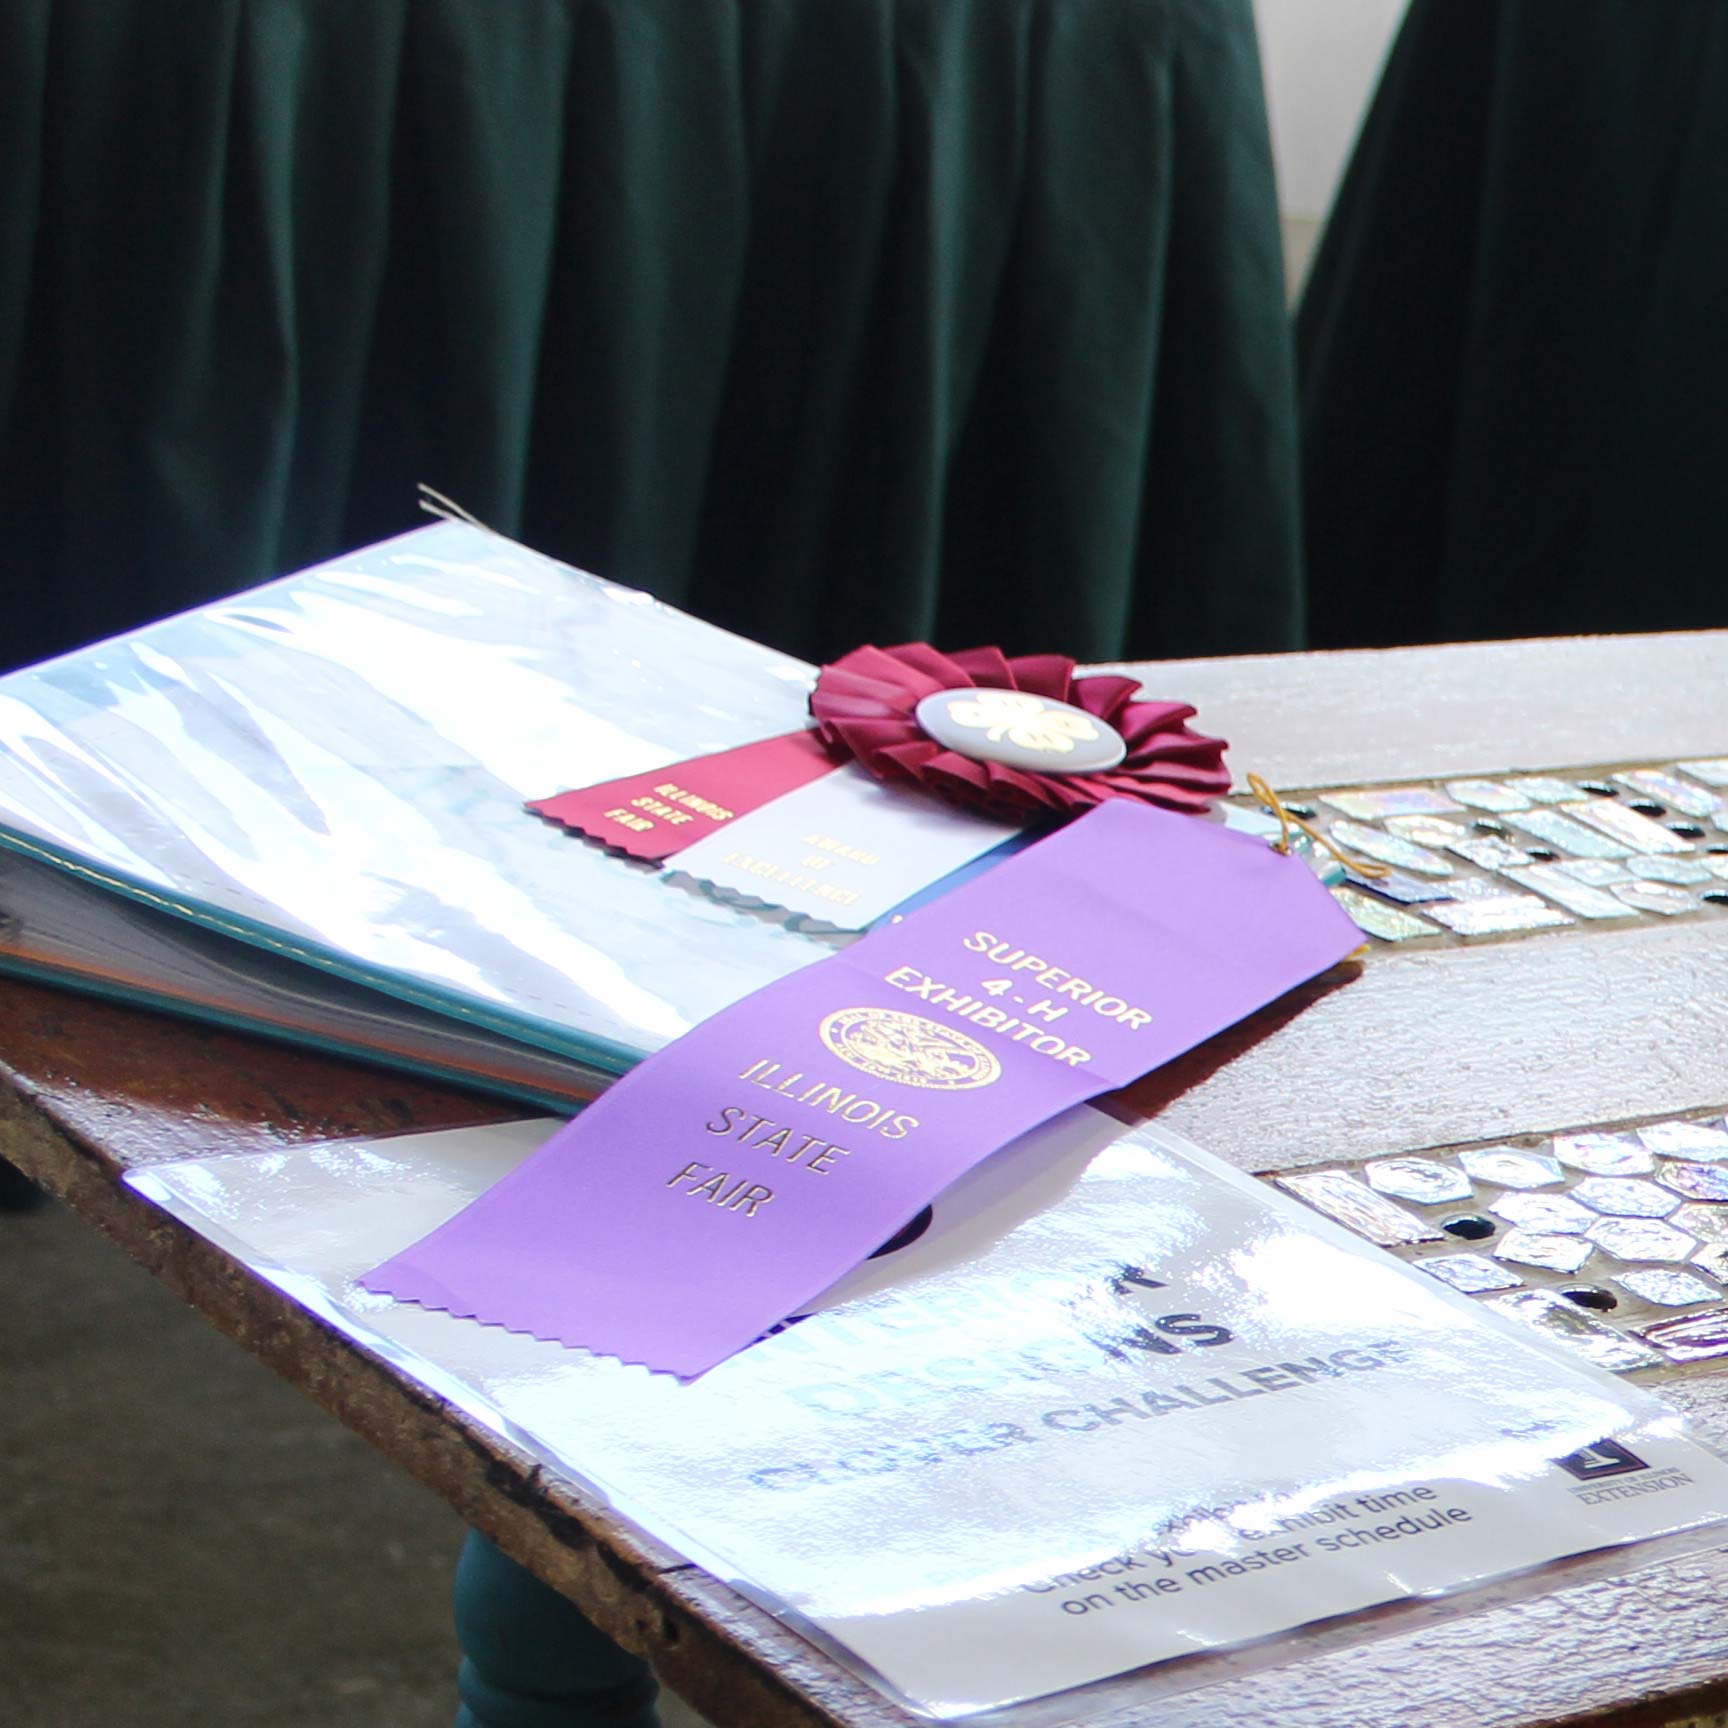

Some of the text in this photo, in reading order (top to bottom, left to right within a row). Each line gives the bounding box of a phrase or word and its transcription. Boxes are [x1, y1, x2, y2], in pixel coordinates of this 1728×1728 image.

[604, 808, 655, 832] FAIR
[631, 796, 694, 825] STATE
[653, 783, 734, 821] ILLINOIS
[963, 931, 1153, 1031] SUPERIOR
[885, 966, 1092, 1067] EXHIBITOR
[738, 1059, 919, 1139] ILLINOIS
[706, 1106, 850, 1175] STATE
[666, 1161, 775, 1217] FAIR
[1041, 1338, 1411, 1432] CHALLENGE
[1237, 1502, 1359, 1542] ehibit
[1355, 1483, 1438, 1516] time
[1576, 1473, 1695, 1505] EXTENSION
[1060, 1593, 1116, 1615] on
[1113, 1577, 1182, 1601] the
[1186, 1543, 1311, 1585] master
[1314, 1503, 1473, 1553] schedule
